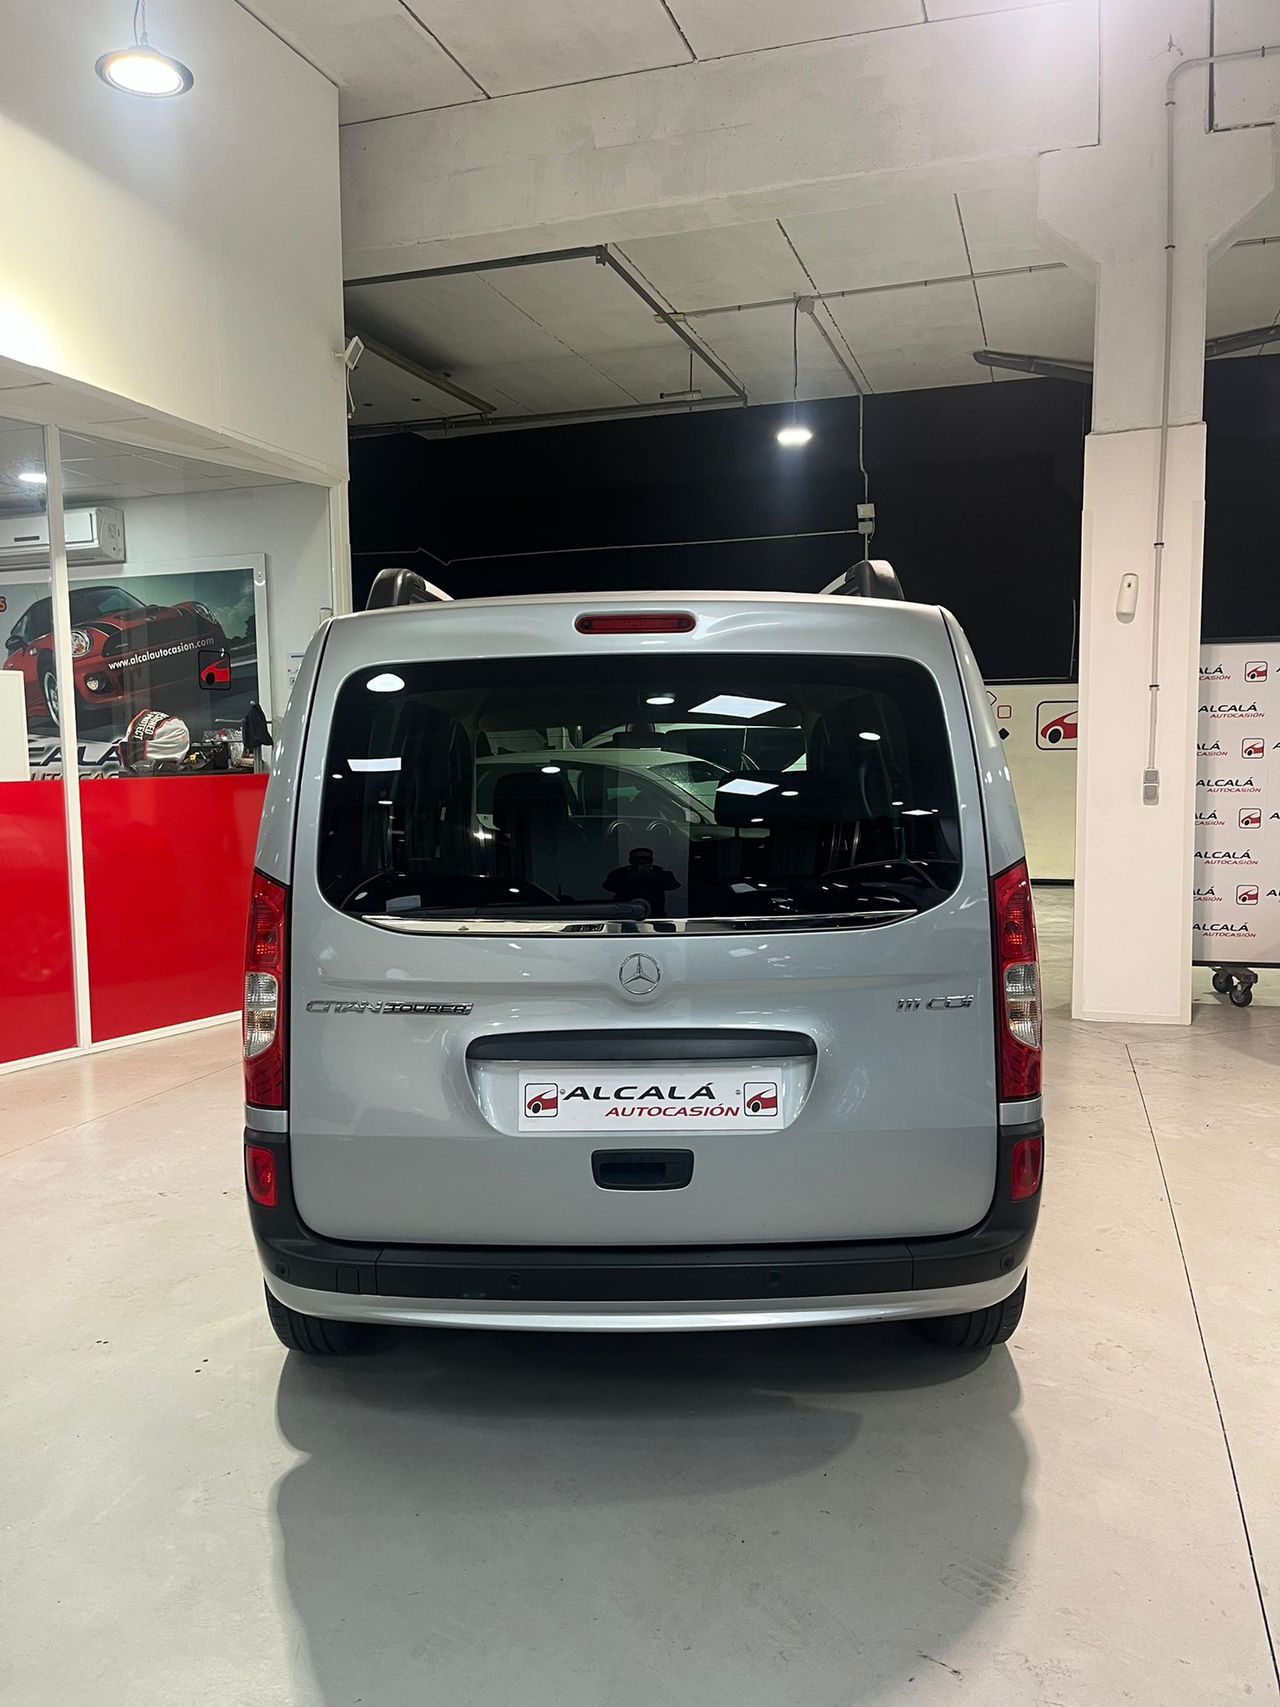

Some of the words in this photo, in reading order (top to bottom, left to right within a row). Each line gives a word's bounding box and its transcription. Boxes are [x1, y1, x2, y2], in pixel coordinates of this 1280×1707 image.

[108, 637, 214, 670] www.alcalautocasion.com
[1198, 702, 1257, 712] ALCALÁ
[1196, 777, 1253, 786] ALCALÁ
[1194, 849, 1251, 859] ALCALÁ
[1193, 922, 1249, 931] ALCALÁ
[305, 1000, 384, 1014] CITAN
[386, 1002, 471, 1014] TOURER
[562, 1082, 716, 1100] ALCALÁ
[605, 1103, 740, 1117] AUTOCASIÓN
